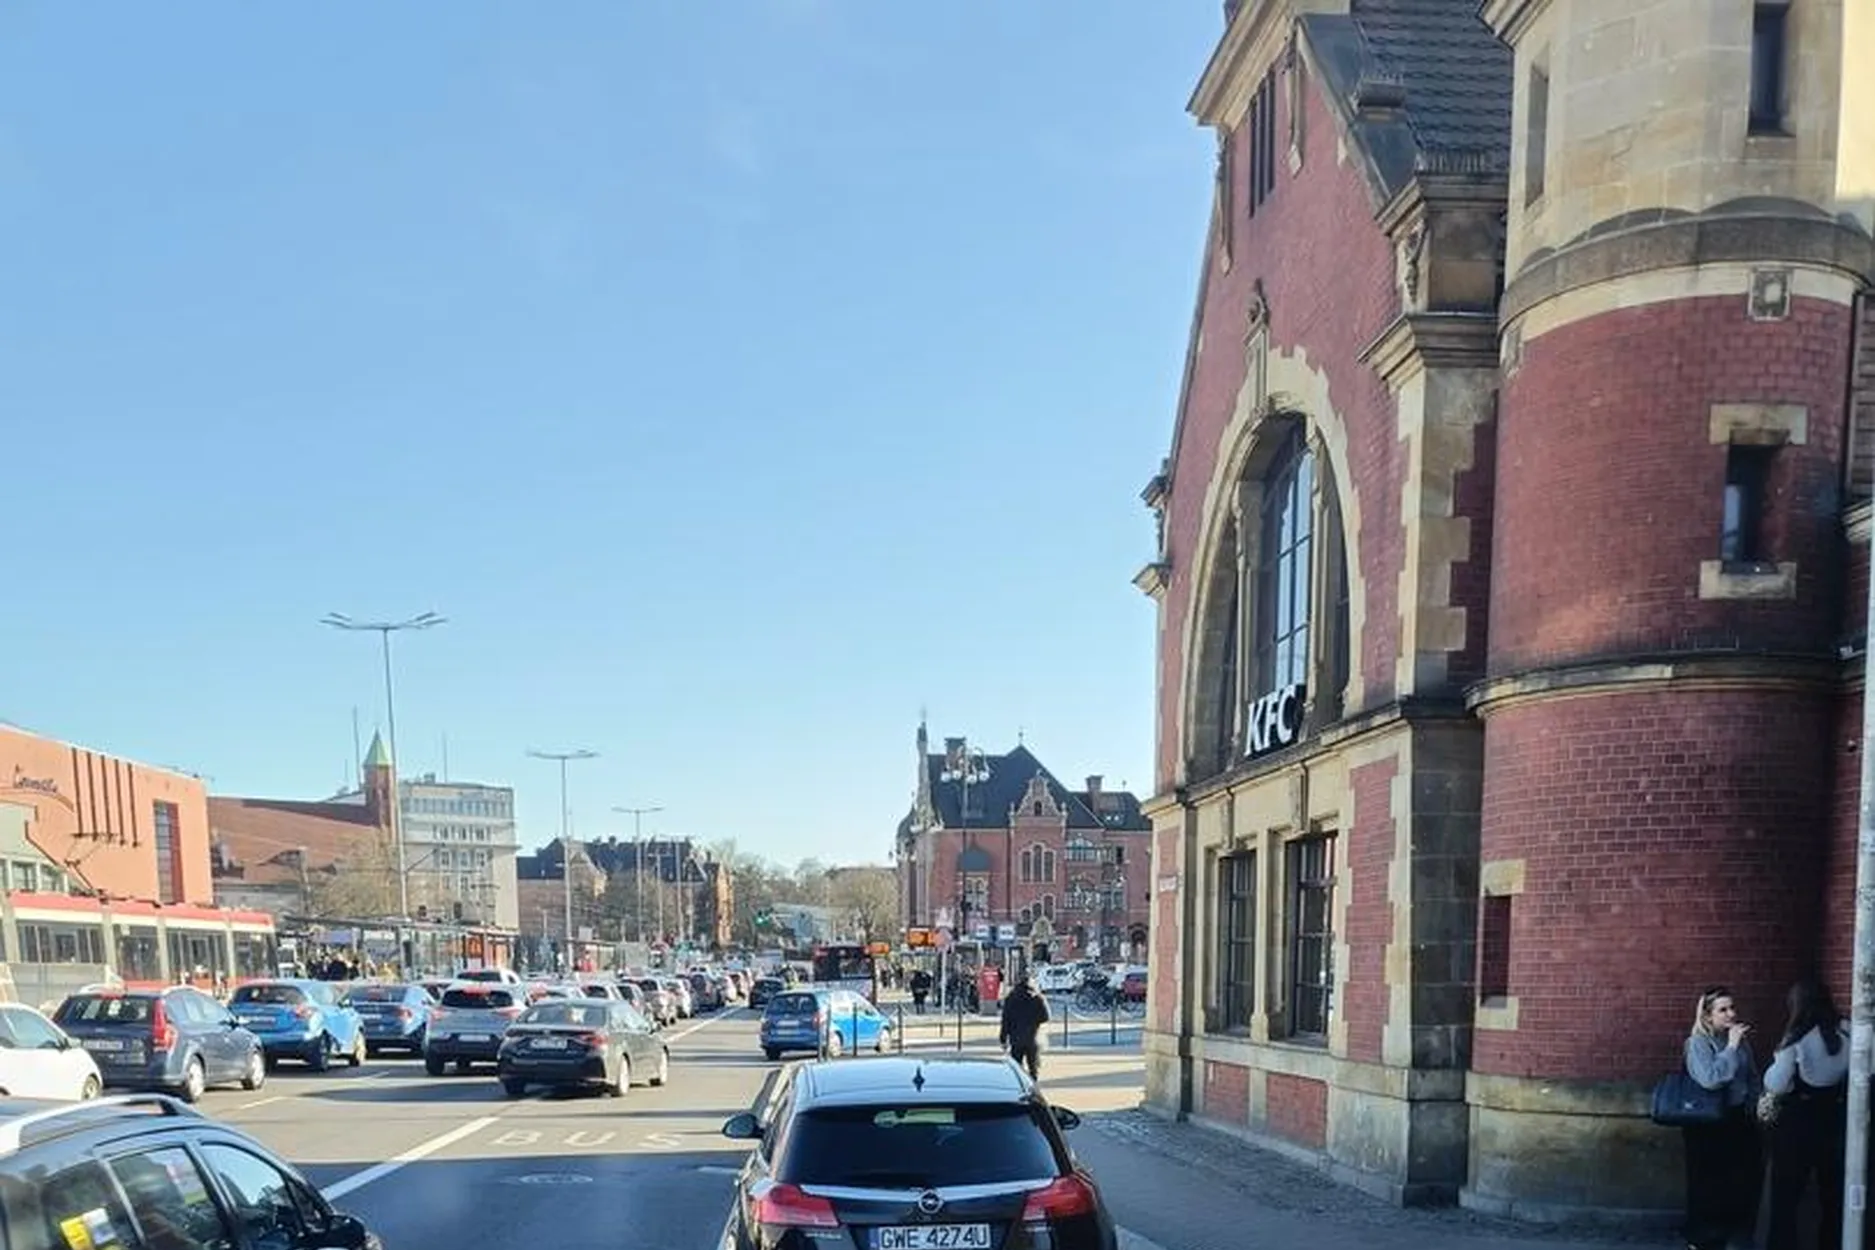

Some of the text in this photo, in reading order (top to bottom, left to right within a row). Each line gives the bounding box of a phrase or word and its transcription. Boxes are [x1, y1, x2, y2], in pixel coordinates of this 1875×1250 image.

[1244, 684, 1296, 756] KFC
[494, 1130, 682, 1148] BUS
[880, 1226, 988, 1249] GWE 4274U
